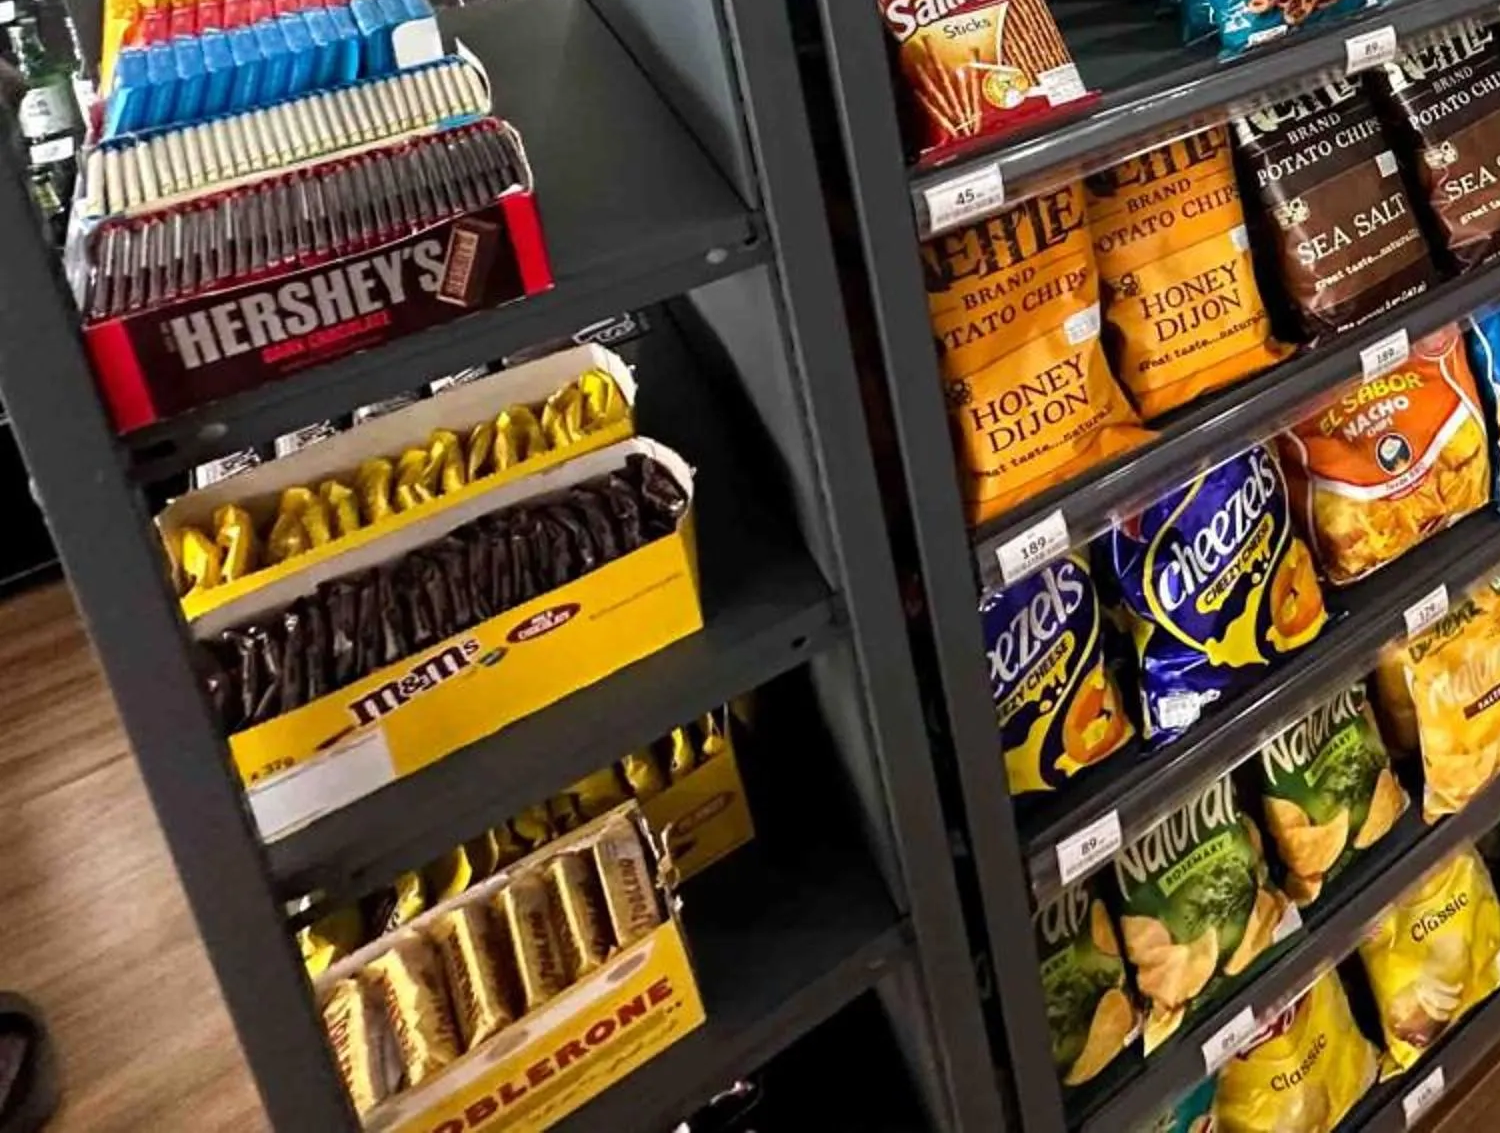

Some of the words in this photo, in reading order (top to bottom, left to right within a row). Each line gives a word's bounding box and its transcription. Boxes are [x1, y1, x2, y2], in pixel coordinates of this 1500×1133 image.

[943, 17, 992, 39] Sticks
[1433, 65, 1474, 95] BRAND
[1286, 112, 1342, 144] BRAND
[1408, 89, 1471, 130] POTATO
[1256, 140, 1333, 187] POTATO
[1444, 166, 1498, 202] SEA
[955, 187, 976, 206] 45
[1127, 176, 1192, 214] BRAND
[1098, 211, 1174, 254] OTATO
[1297, 226, 1353, 266] SEA
[1353, 193, 1408, 237] SALT
[170, 239, 447, 369] HERSHEY'S
[940, 302, 1016, 351] TATO
[1022, 266, 1090, 314] CHIPS
[962, 267, 1036, 312] BRAND
[1141, 259, 1240, 321] HONEY
[1154, 288, 1243, 343] DIJON
[971, 352, 1087, 432] HONEY
[1319, 408, 1345, 437] EL
[1341, 371, 1425, 414] SABOR
[987, 384, 1092, 454] DIJON
[1342, 395, 1410, 442] NACHO
[1020, 536, 1047, 560] 189
[1165, 840, 1226, 887] ROSEMARY
[1411, 890, 1470, 944] Classic
[433, 976, 674, 1133] OBLERONE
[1270, 1033, 1329, 1093] Classic
